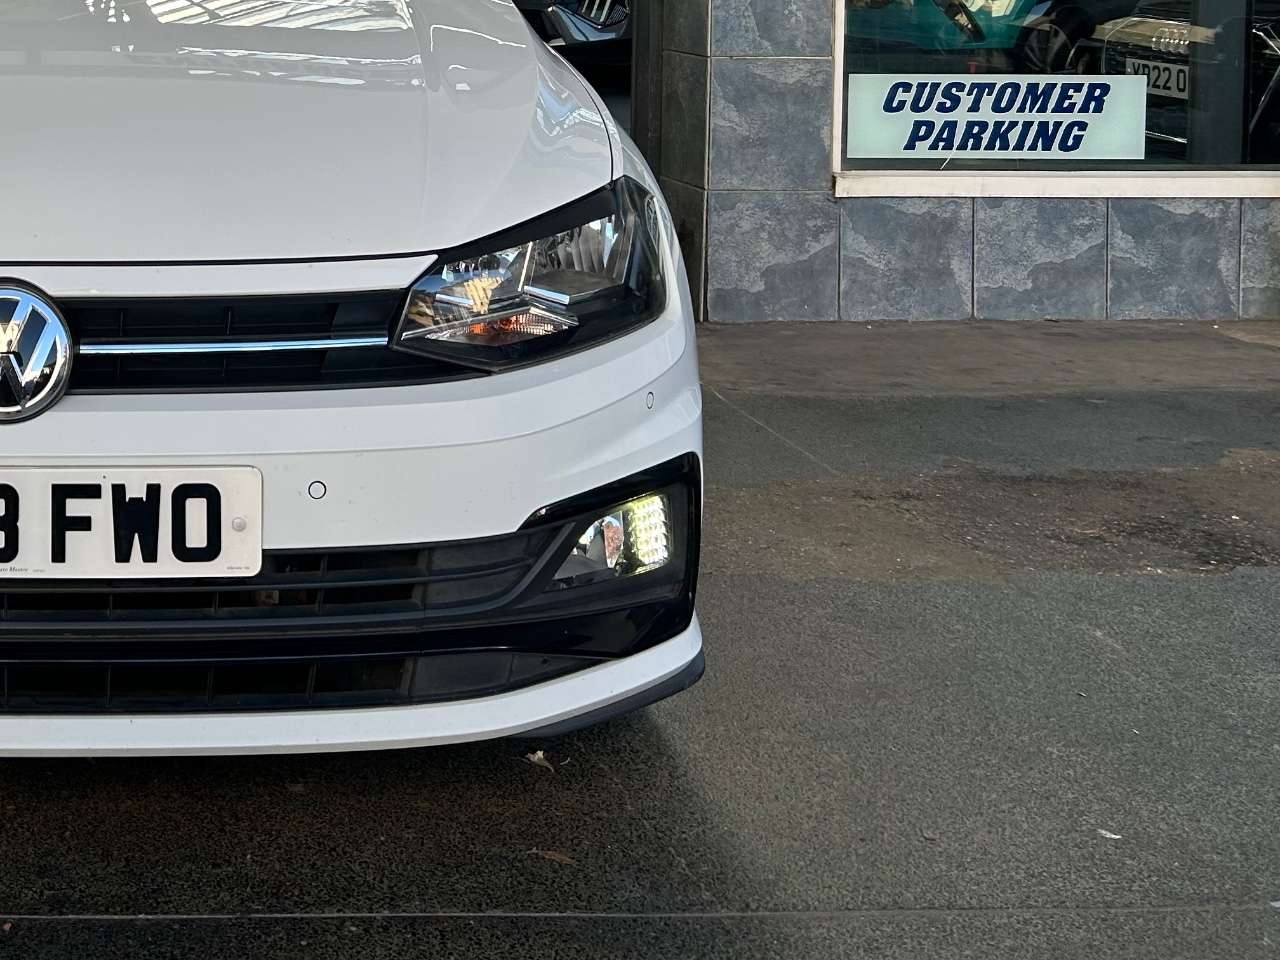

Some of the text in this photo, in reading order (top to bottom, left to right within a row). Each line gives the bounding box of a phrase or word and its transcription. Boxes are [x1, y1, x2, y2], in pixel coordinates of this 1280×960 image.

[882, 81, 1111, 114] CUSTOMER
[902, 119, 1089, 152] PARKING
[51, 482, 222, 564] FWO
